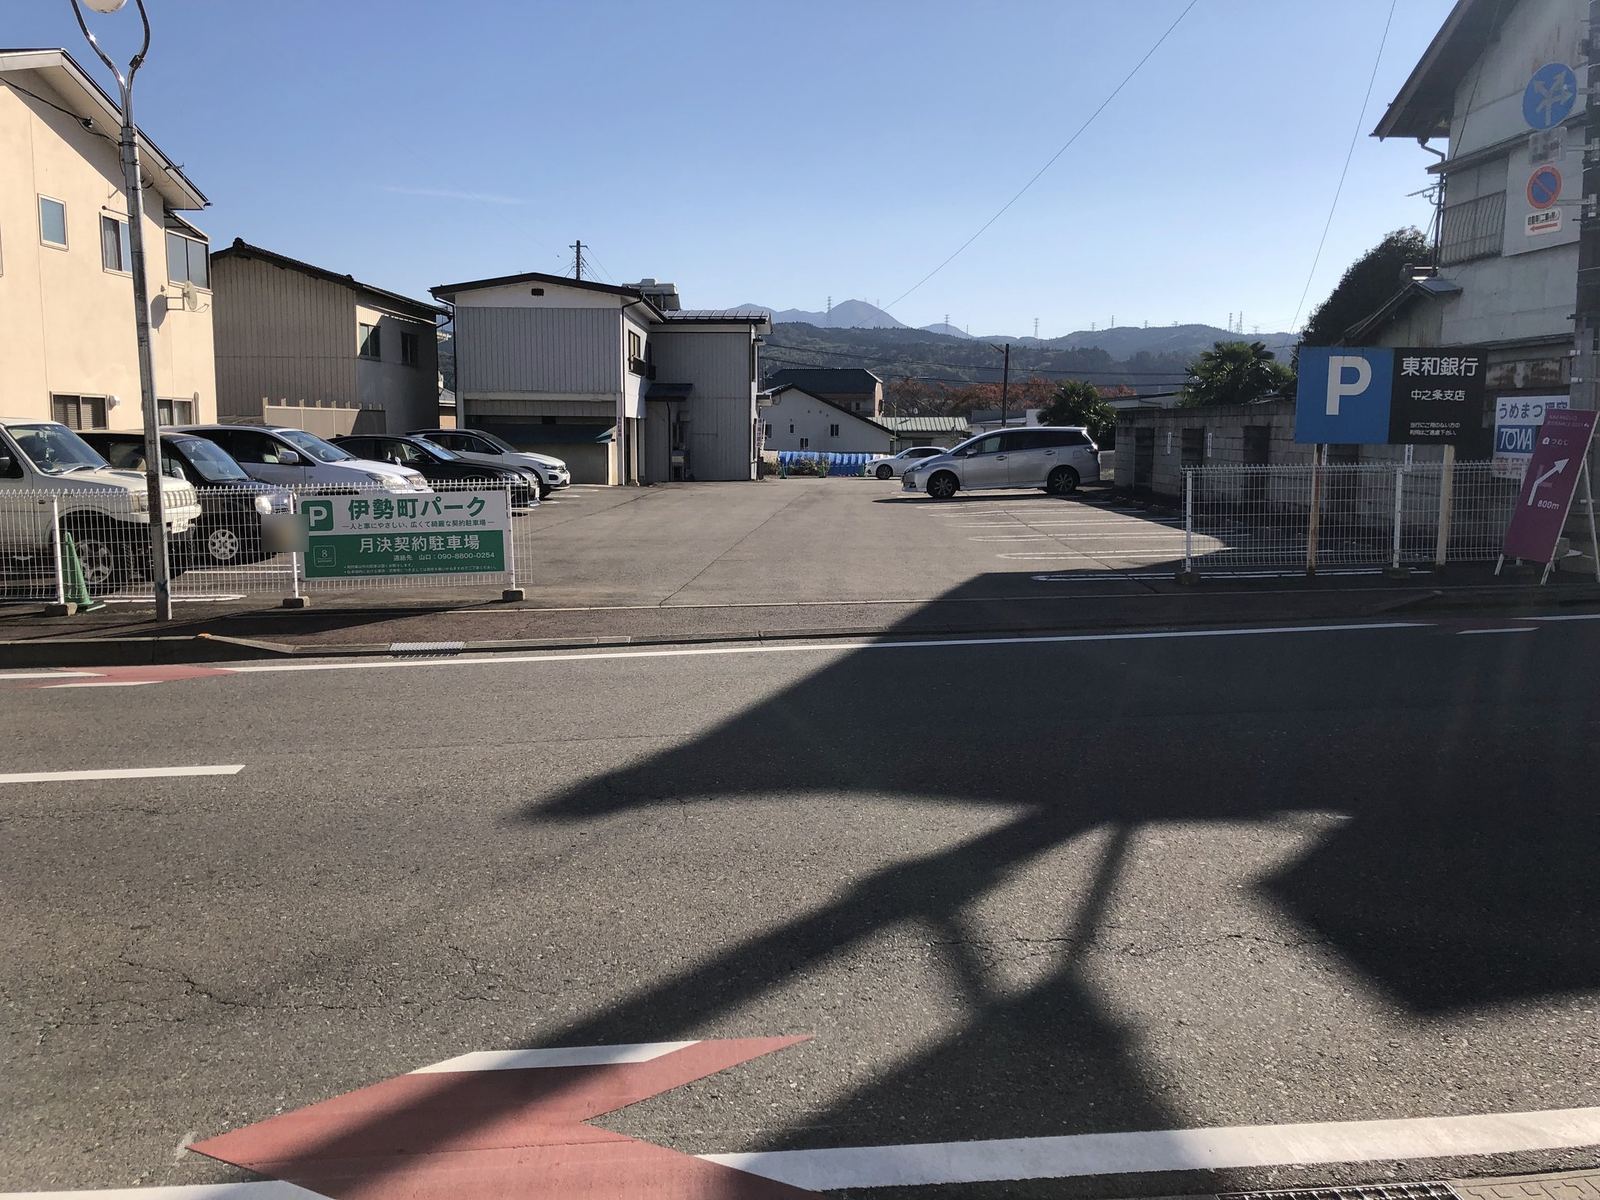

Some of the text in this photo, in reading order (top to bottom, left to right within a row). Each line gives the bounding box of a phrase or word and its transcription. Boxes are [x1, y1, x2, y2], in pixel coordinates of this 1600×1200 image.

[1400, 356, 1479, 378] 東和銀行
[1326, 355, 1372, 416] P
[1410, 389, 1466, 402] 中之条支店
[1500, 427, 1533, 450] TOWA
[347, 495, 487, 521] 伊勢町パーク
[1537, 499, 1560, 511] 800m
[309, 506, 328, 528] P
[359, 534, 481, 554] 月決契約駐車場
